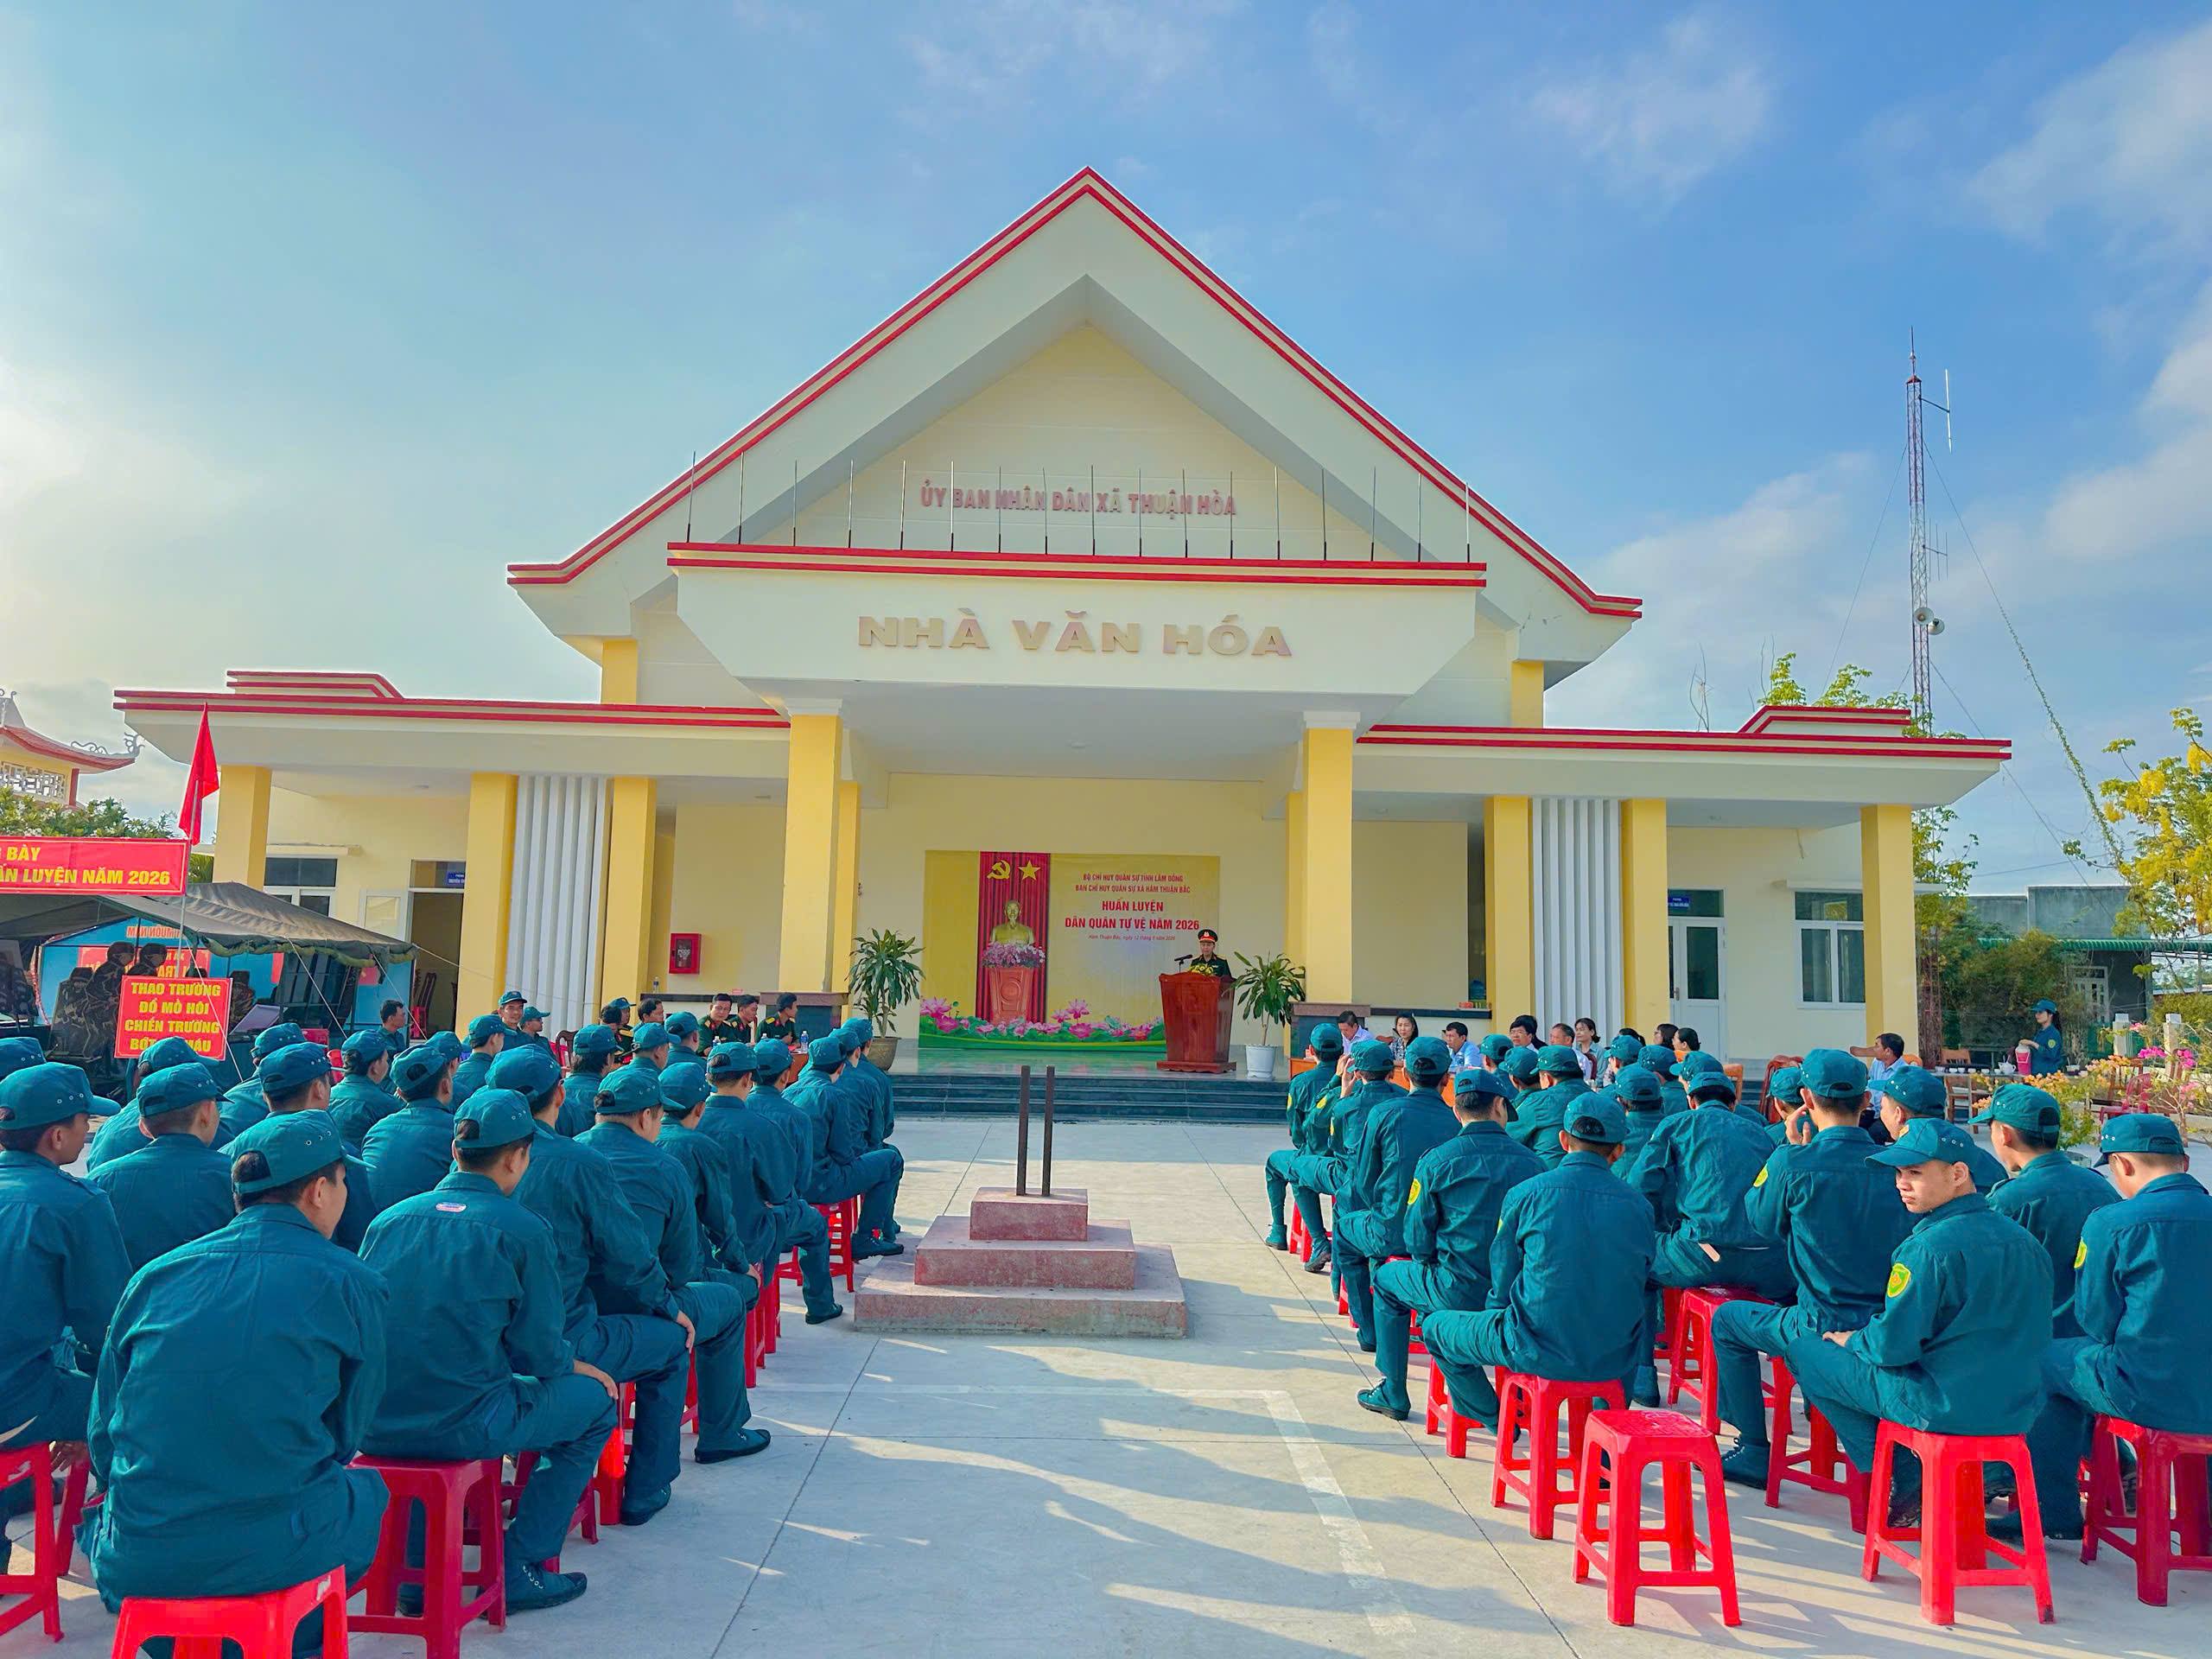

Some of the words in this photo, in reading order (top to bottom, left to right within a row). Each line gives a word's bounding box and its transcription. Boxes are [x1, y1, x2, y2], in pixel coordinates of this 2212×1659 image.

[921, 479, 947, 507] ỦY
[953, 488, 990, 509] BAN
[995, 485, 1046, 511] NHÂN
[1052, 486, 1090, 512] DÂN
[1096, 487, 1122, 512] XÃ
[1128, 488, 1192, 519] THUẬN
[1198, 489, 1236, 515] HÒA
[858, 607, 990, 649] NHÀ
[1012, 610, 1141, 652] VĂN
[1163, 614, 1293, 657] HÓA
[6, 843, 41, 861] BÀY
[22, 866, 78, 886] LUYỆN
[82, 867, 124, 884] NĂM
[128, 870, 170, 885] 2026
[1102, 897, 1129, 912] HUẤN
[1132, 899, 1164, 914] LUYỆN
[1065, 915, 1086, 928] DÂN
[1089, 916, 1116, 929] QUÂN
[1120, 917, 1133, 931] TỰ
[1134, 917, 1147, 931] VỆ
[1149, 918, 1173, 930] NĂM
[1175, 919, 1199, 931] 2026
[130, 982, 165, 995] THAO
[168, 981, 221, 996] TRƯỜNG
[186, 1001, 209, 1014] HÔI
[124, 1016, 163, 1032] CHIẾN
[168, 1019, 220, 1033] TRƯỜNG
